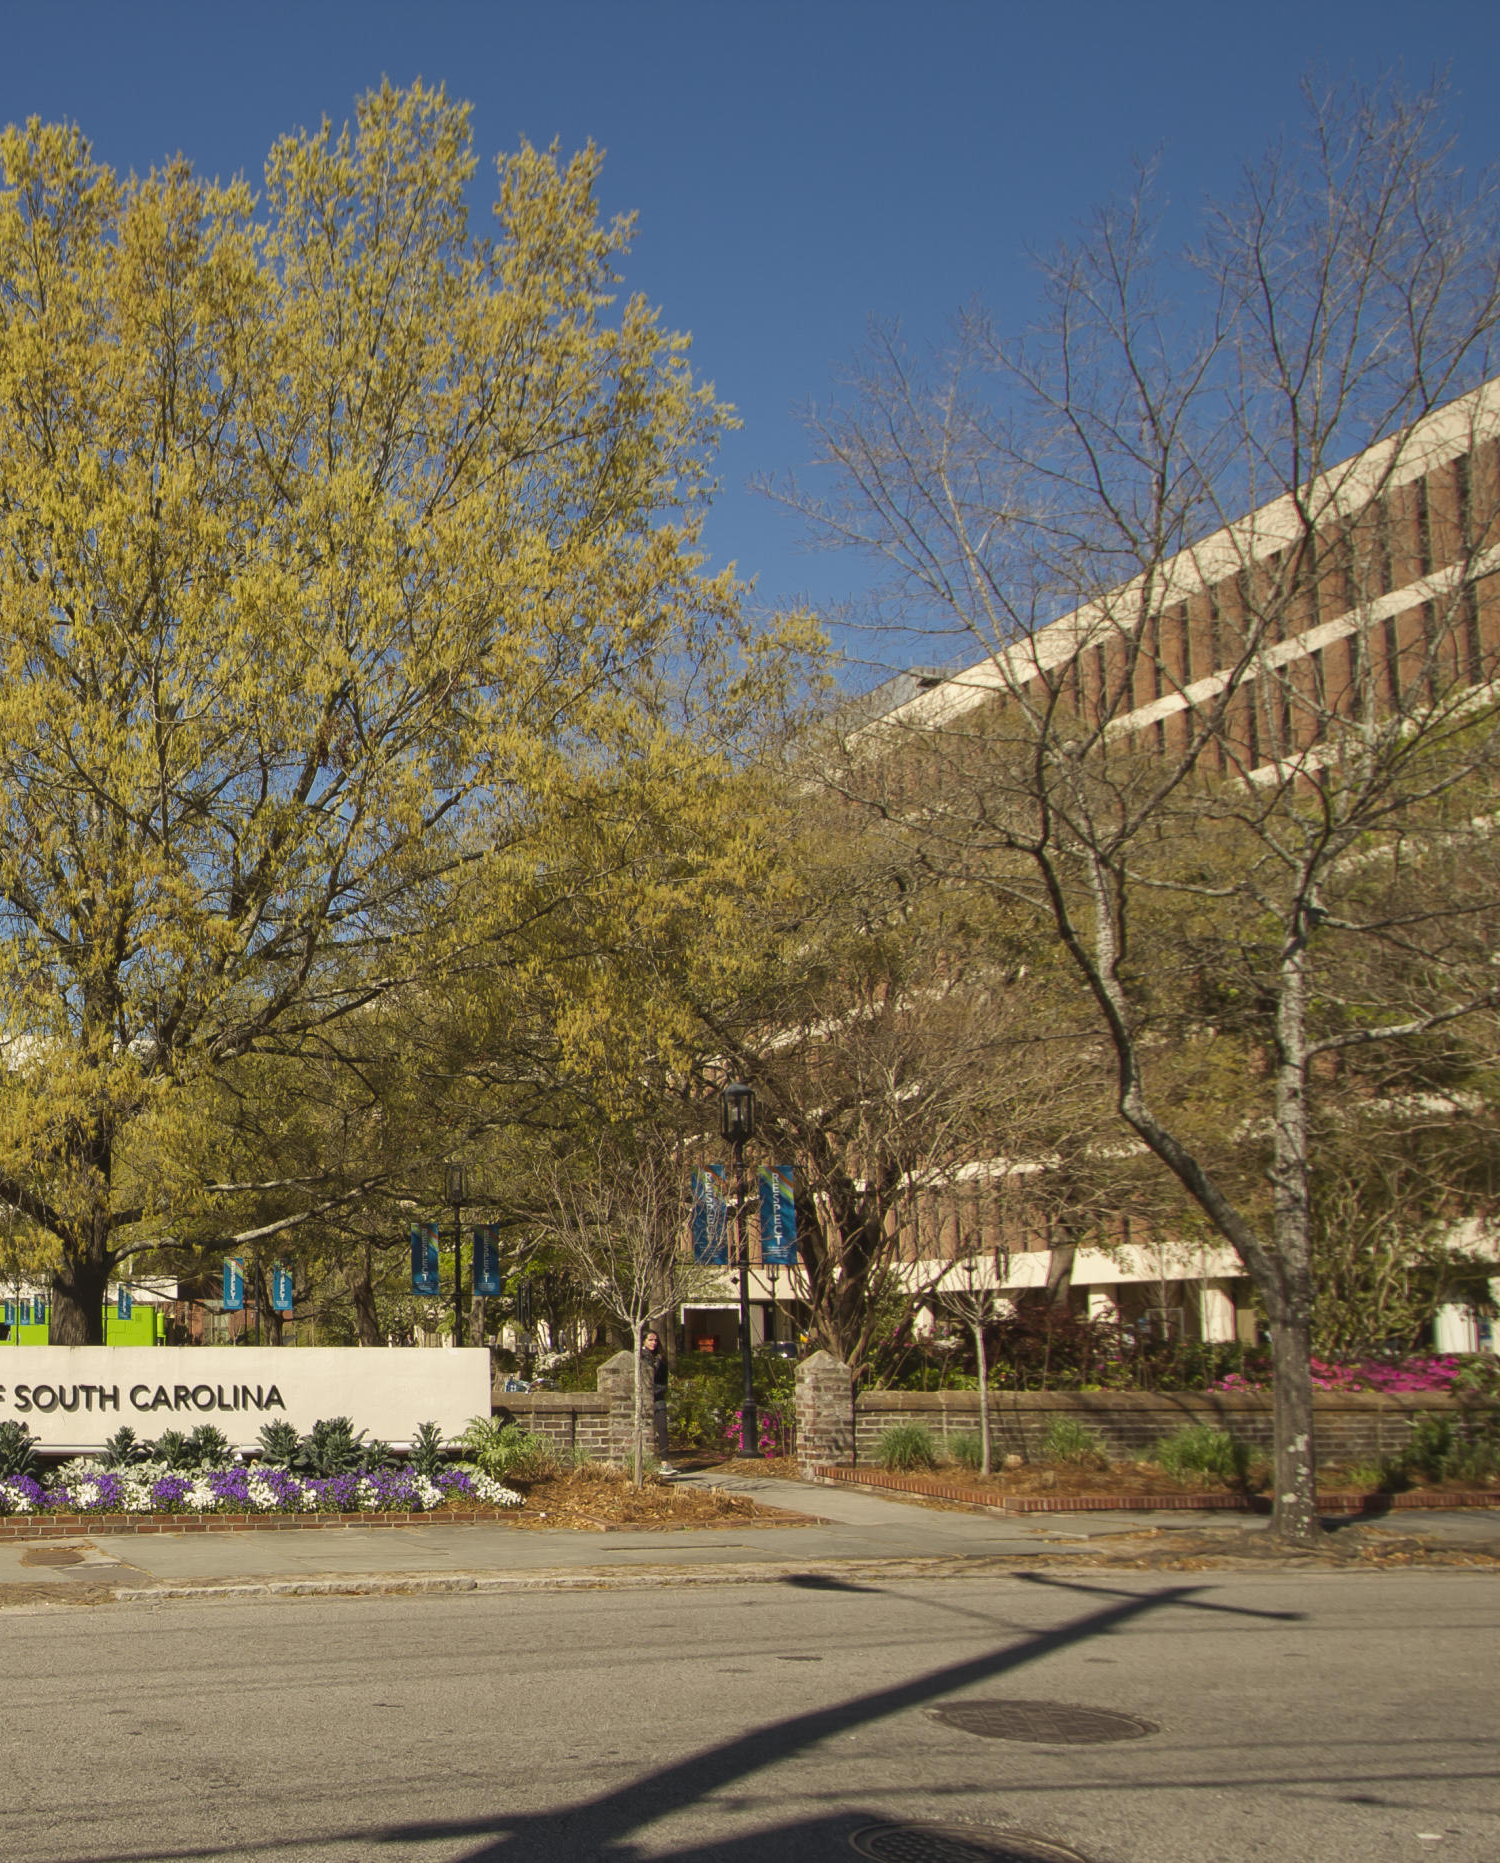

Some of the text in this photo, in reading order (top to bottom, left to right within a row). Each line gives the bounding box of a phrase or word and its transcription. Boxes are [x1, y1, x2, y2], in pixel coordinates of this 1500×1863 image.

[772, 1172, 783, 1245] RESPECT
[14, 1384, 119, 1411] SOUTH
[130, 1385, 285, 1411] CAROLINA
